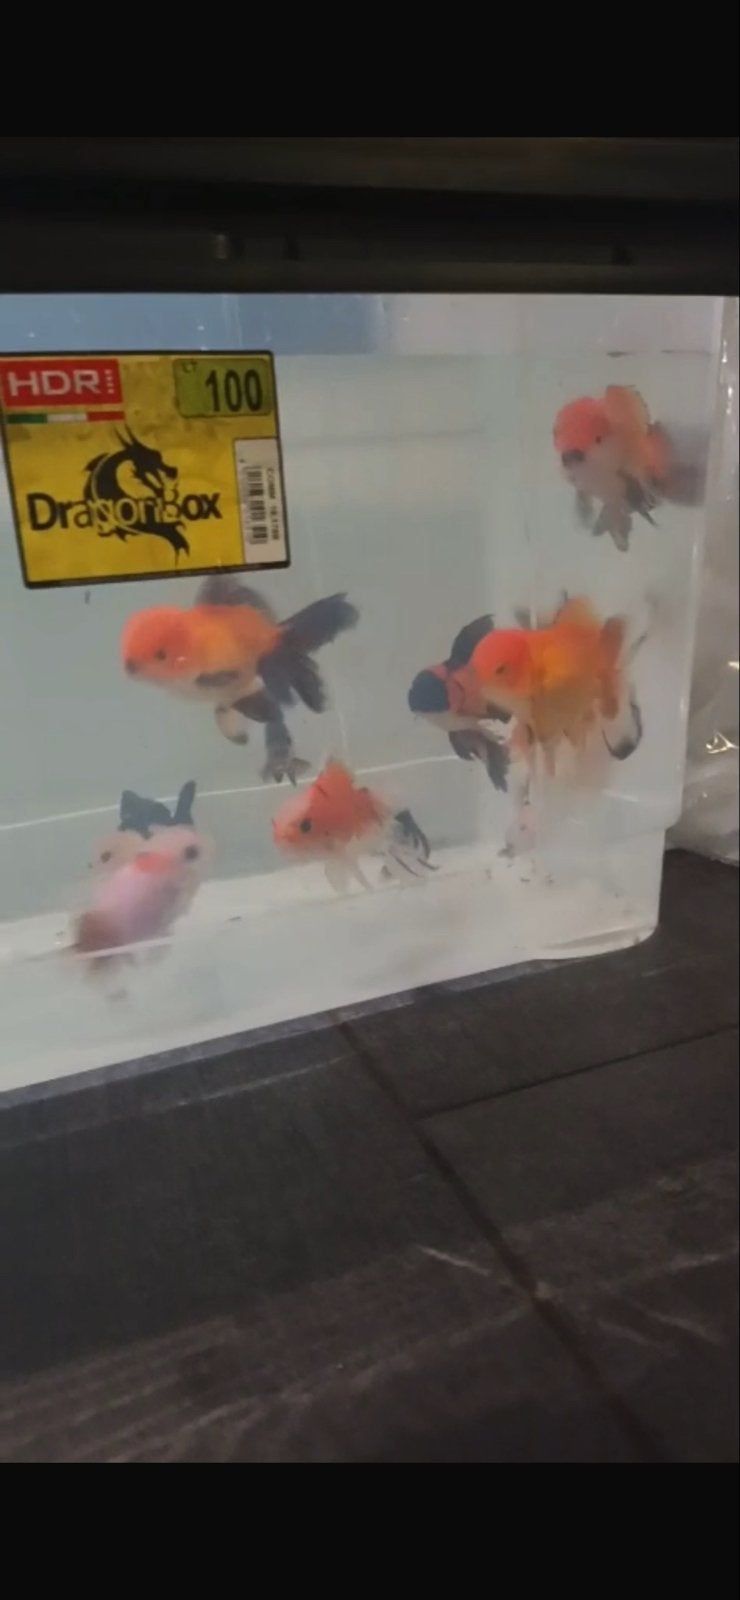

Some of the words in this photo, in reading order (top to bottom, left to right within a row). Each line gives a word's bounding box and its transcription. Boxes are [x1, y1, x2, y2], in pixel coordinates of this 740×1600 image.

[7, 369, 101, 396] HDR
[205, 369, 263, 412] 100
[27, 485, 222, 534] DragonBox
